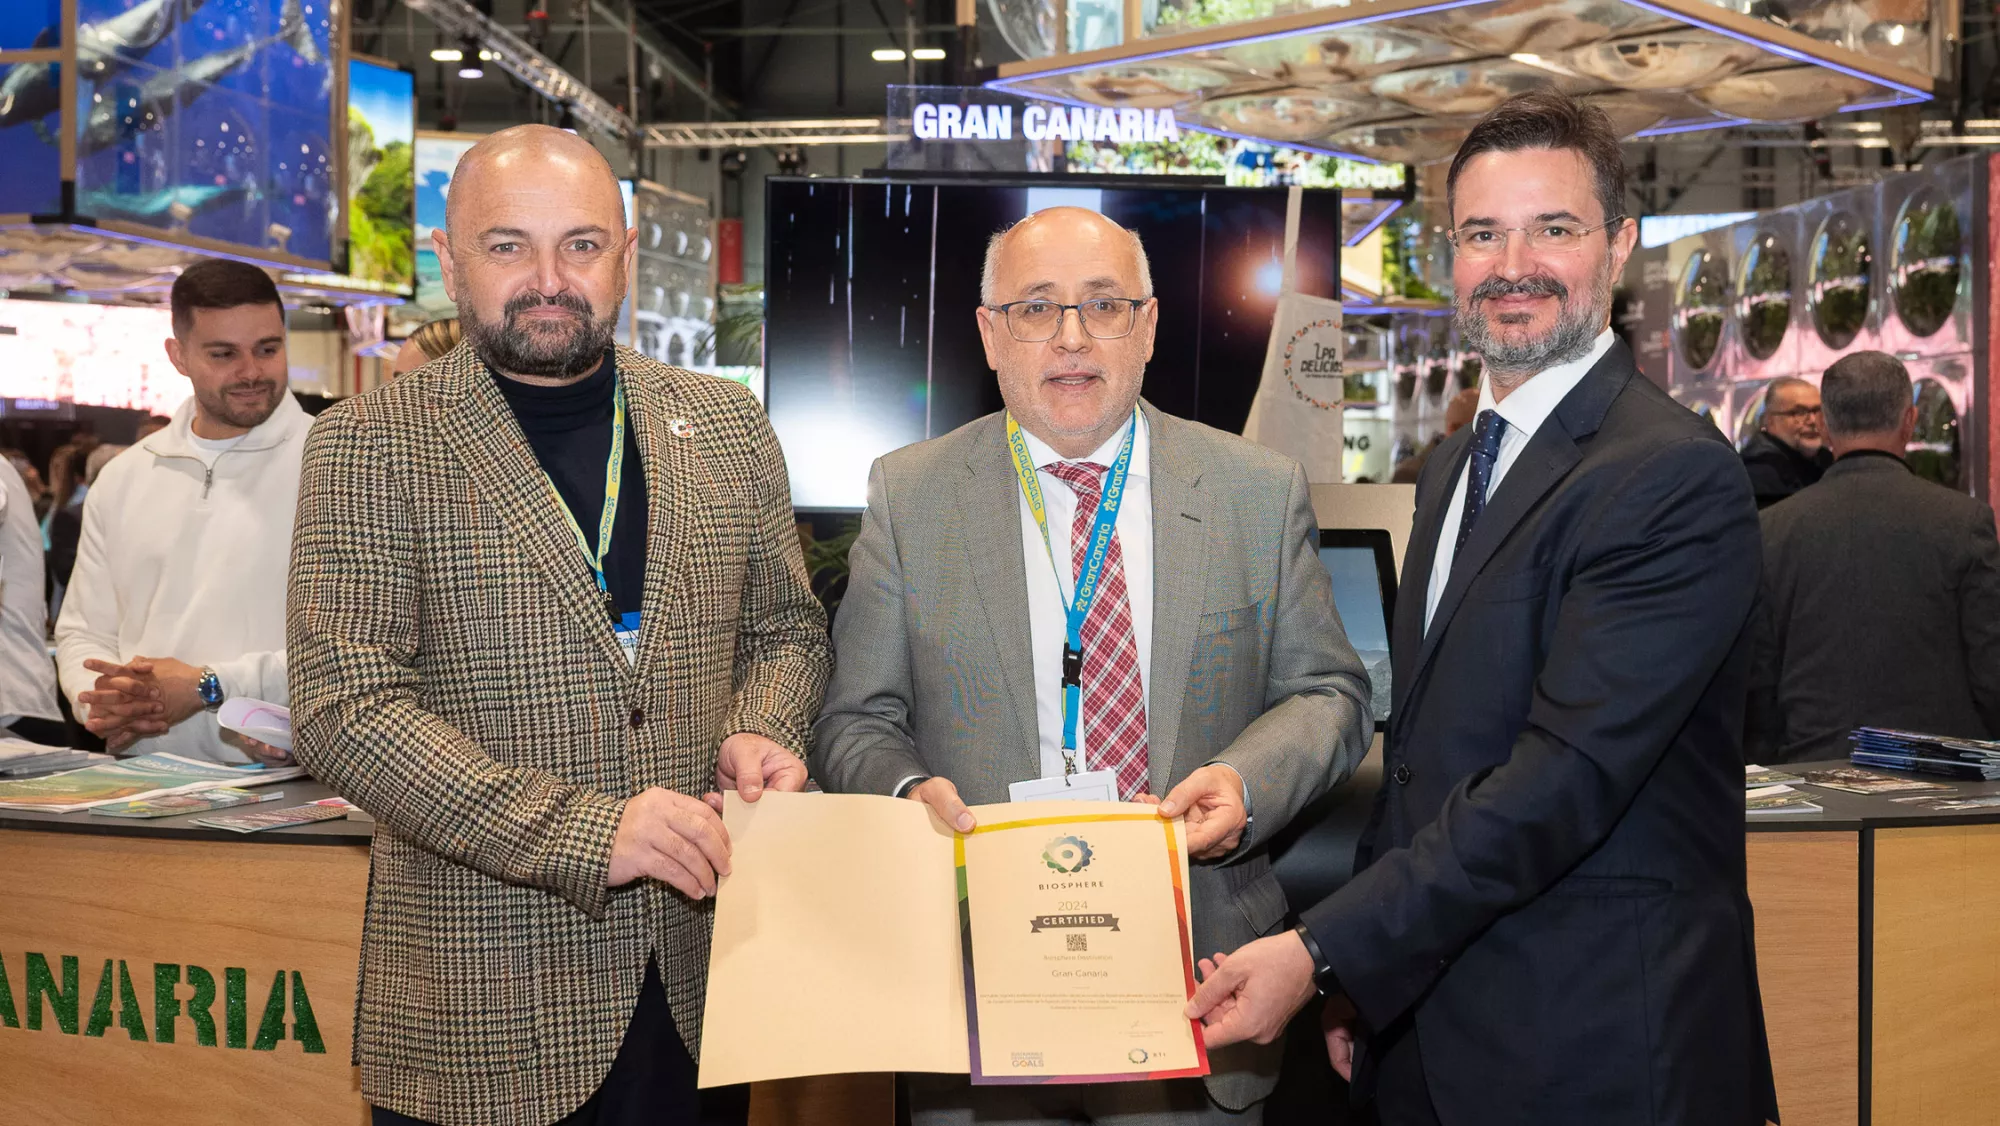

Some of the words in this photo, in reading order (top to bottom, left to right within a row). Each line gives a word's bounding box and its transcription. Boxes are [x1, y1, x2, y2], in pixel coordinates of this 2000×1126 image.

[913, 103, 1013, 140] GRAN
[1022, 105, 1179, 142] CANARIA
[1080, 523, 1110, 597] GranCanaria
[1038, 881, 1104, 890] BIOSPHERE
[1057, 900, 1088, 911] 2024
[1042, 916, 1105, 925] CERTIFIED
[1051, 969, 1073, 978] Gran
[1075, 968, 1108, 978] Canaria
[1012, 1060, 1044, 1068] GOALS
